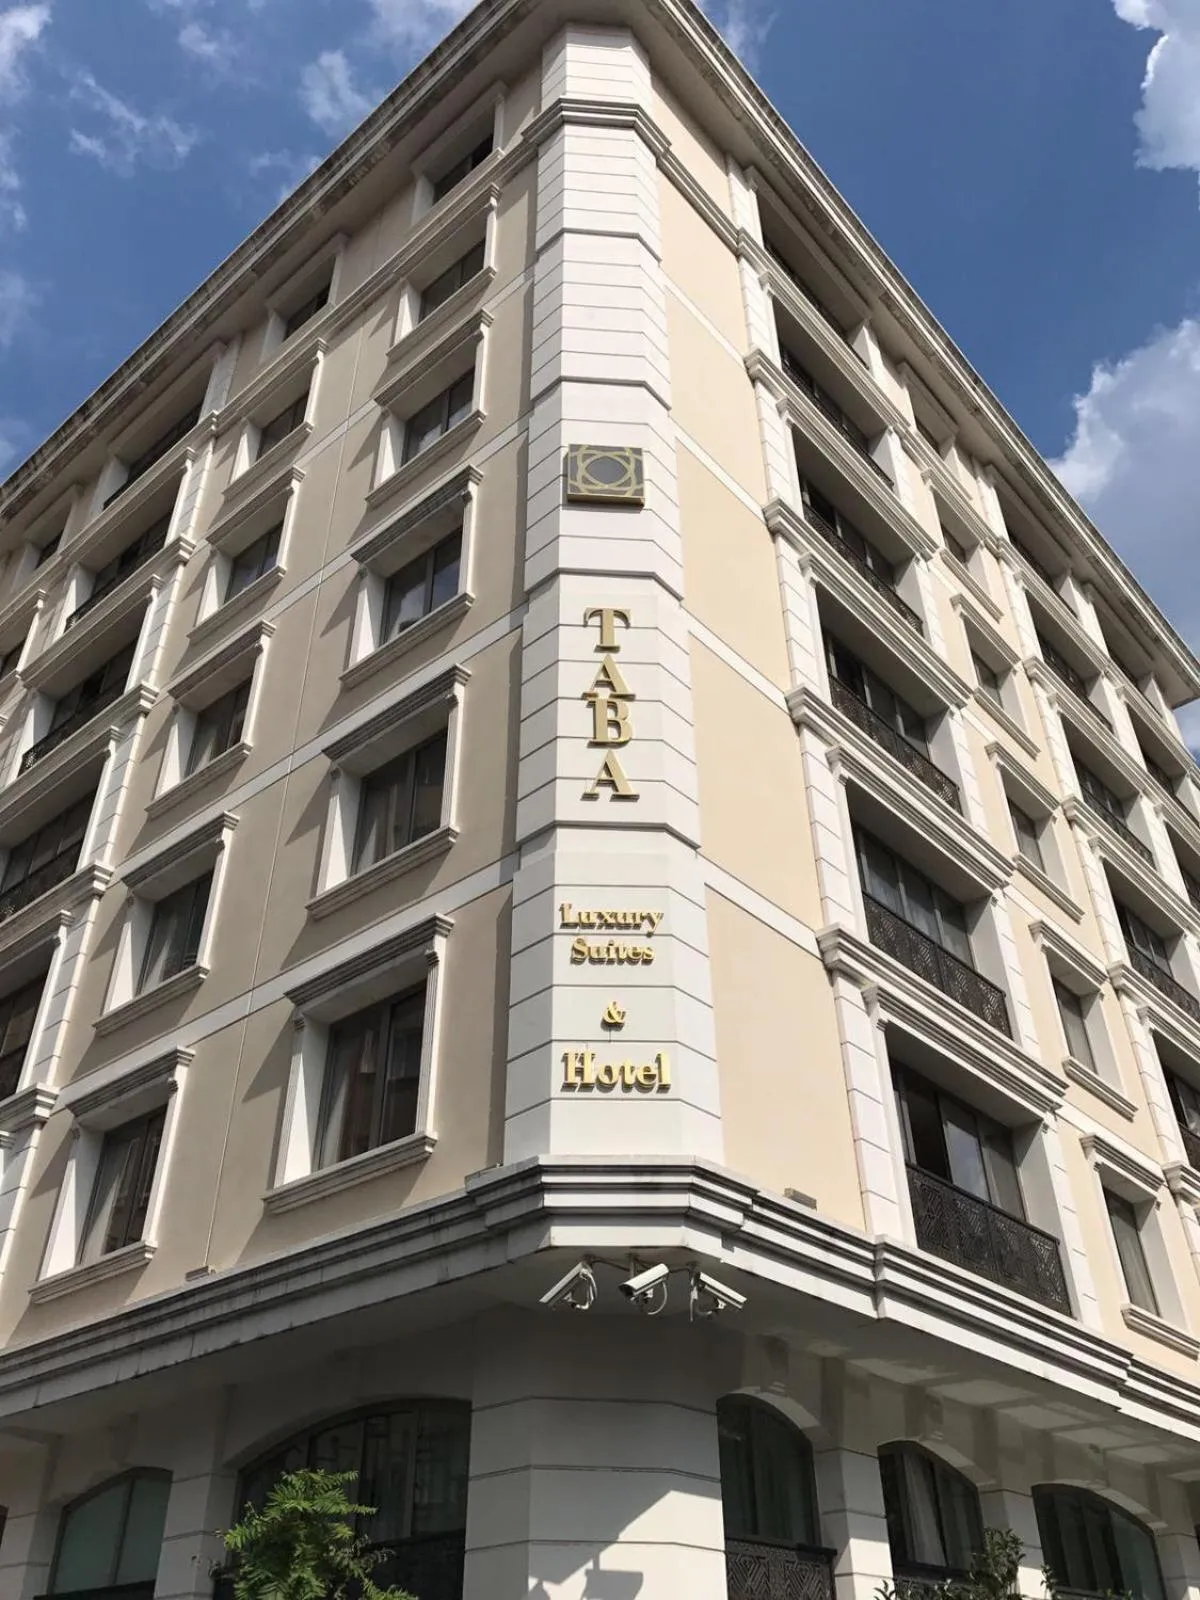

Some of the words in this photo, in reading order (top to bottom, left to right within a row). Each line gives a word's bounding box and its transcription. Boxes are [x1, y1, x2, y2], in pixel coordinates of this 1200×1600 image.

[582, 607, 640, 802] TABA
[559, 903, 664, 937] Luxury
[571, 938, 656, 964] Suites
[601, 1001, 626, 1030] &
[561, 1050, 671, 1093] Hotel
